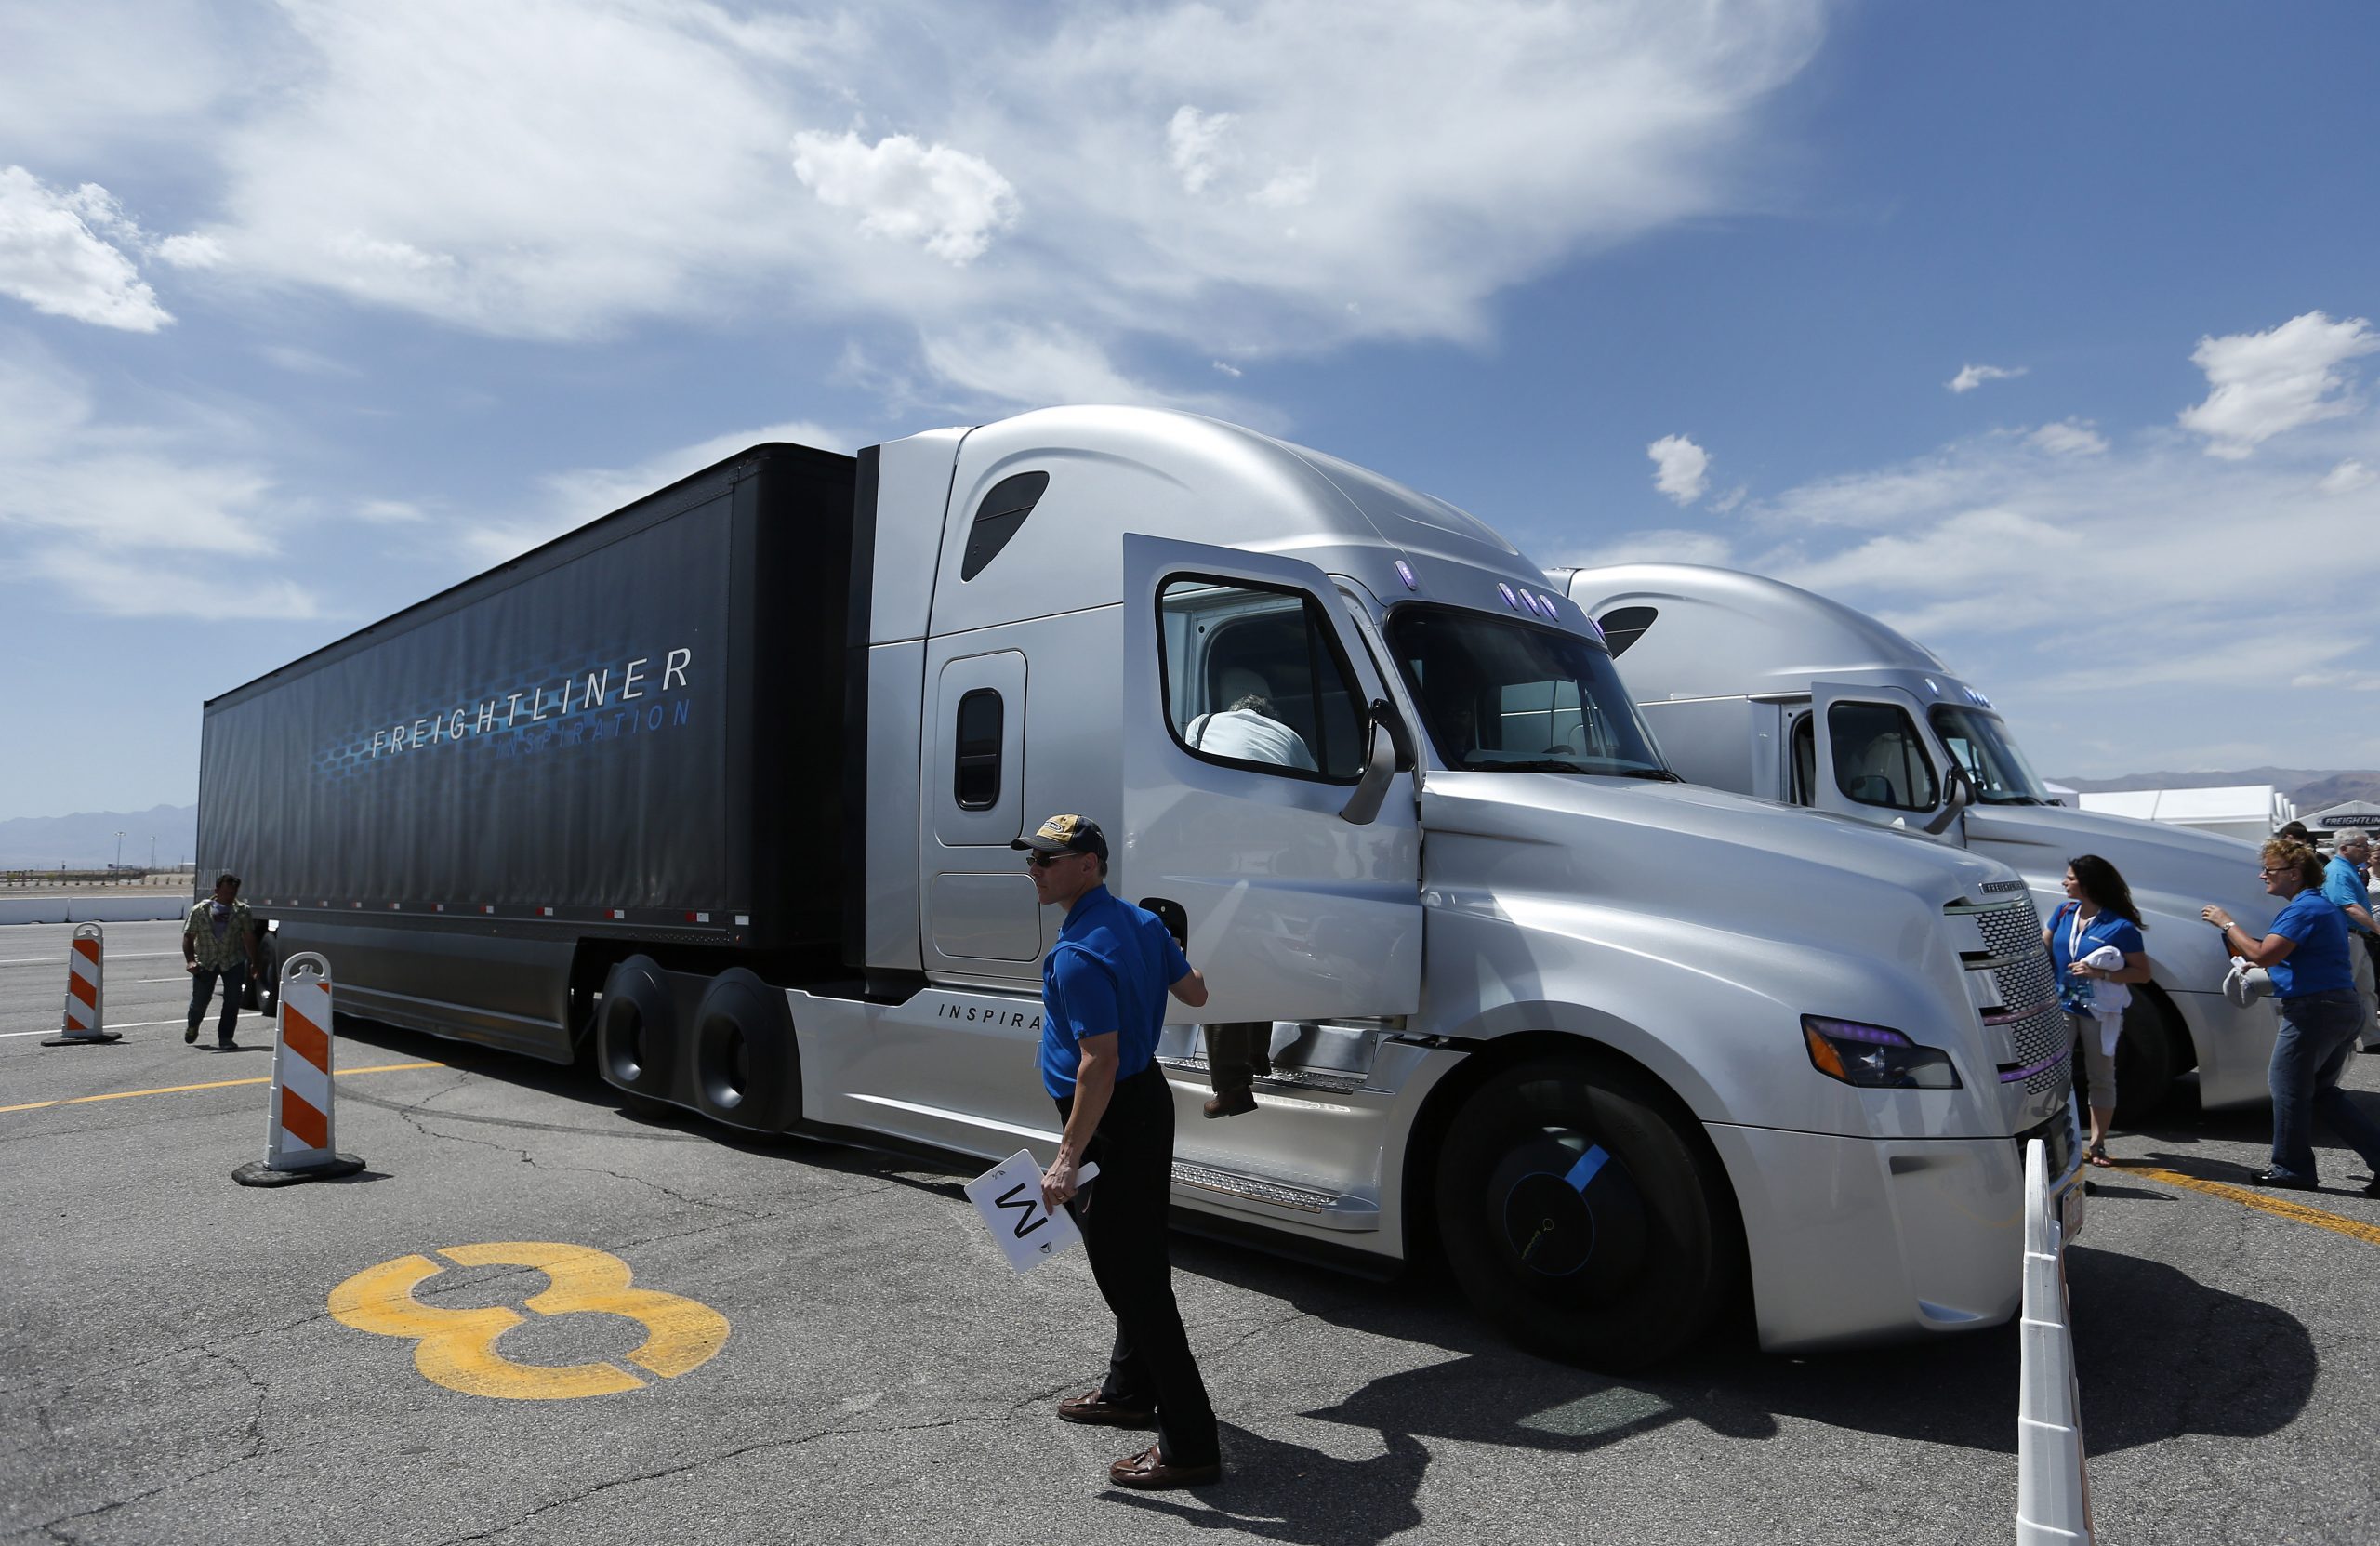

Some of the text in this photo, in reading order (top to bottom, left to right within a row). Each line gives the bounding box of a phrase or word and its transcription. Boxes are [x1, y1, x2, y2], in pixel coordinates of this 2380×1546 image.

[372, 648, 691, 758] FREIGHTLINER
[496, 698, 690, 759] INSPIRATION
[938, 1003, 1040, 1030] INSPIRA
[327, 1241, 732, 1400] 8
